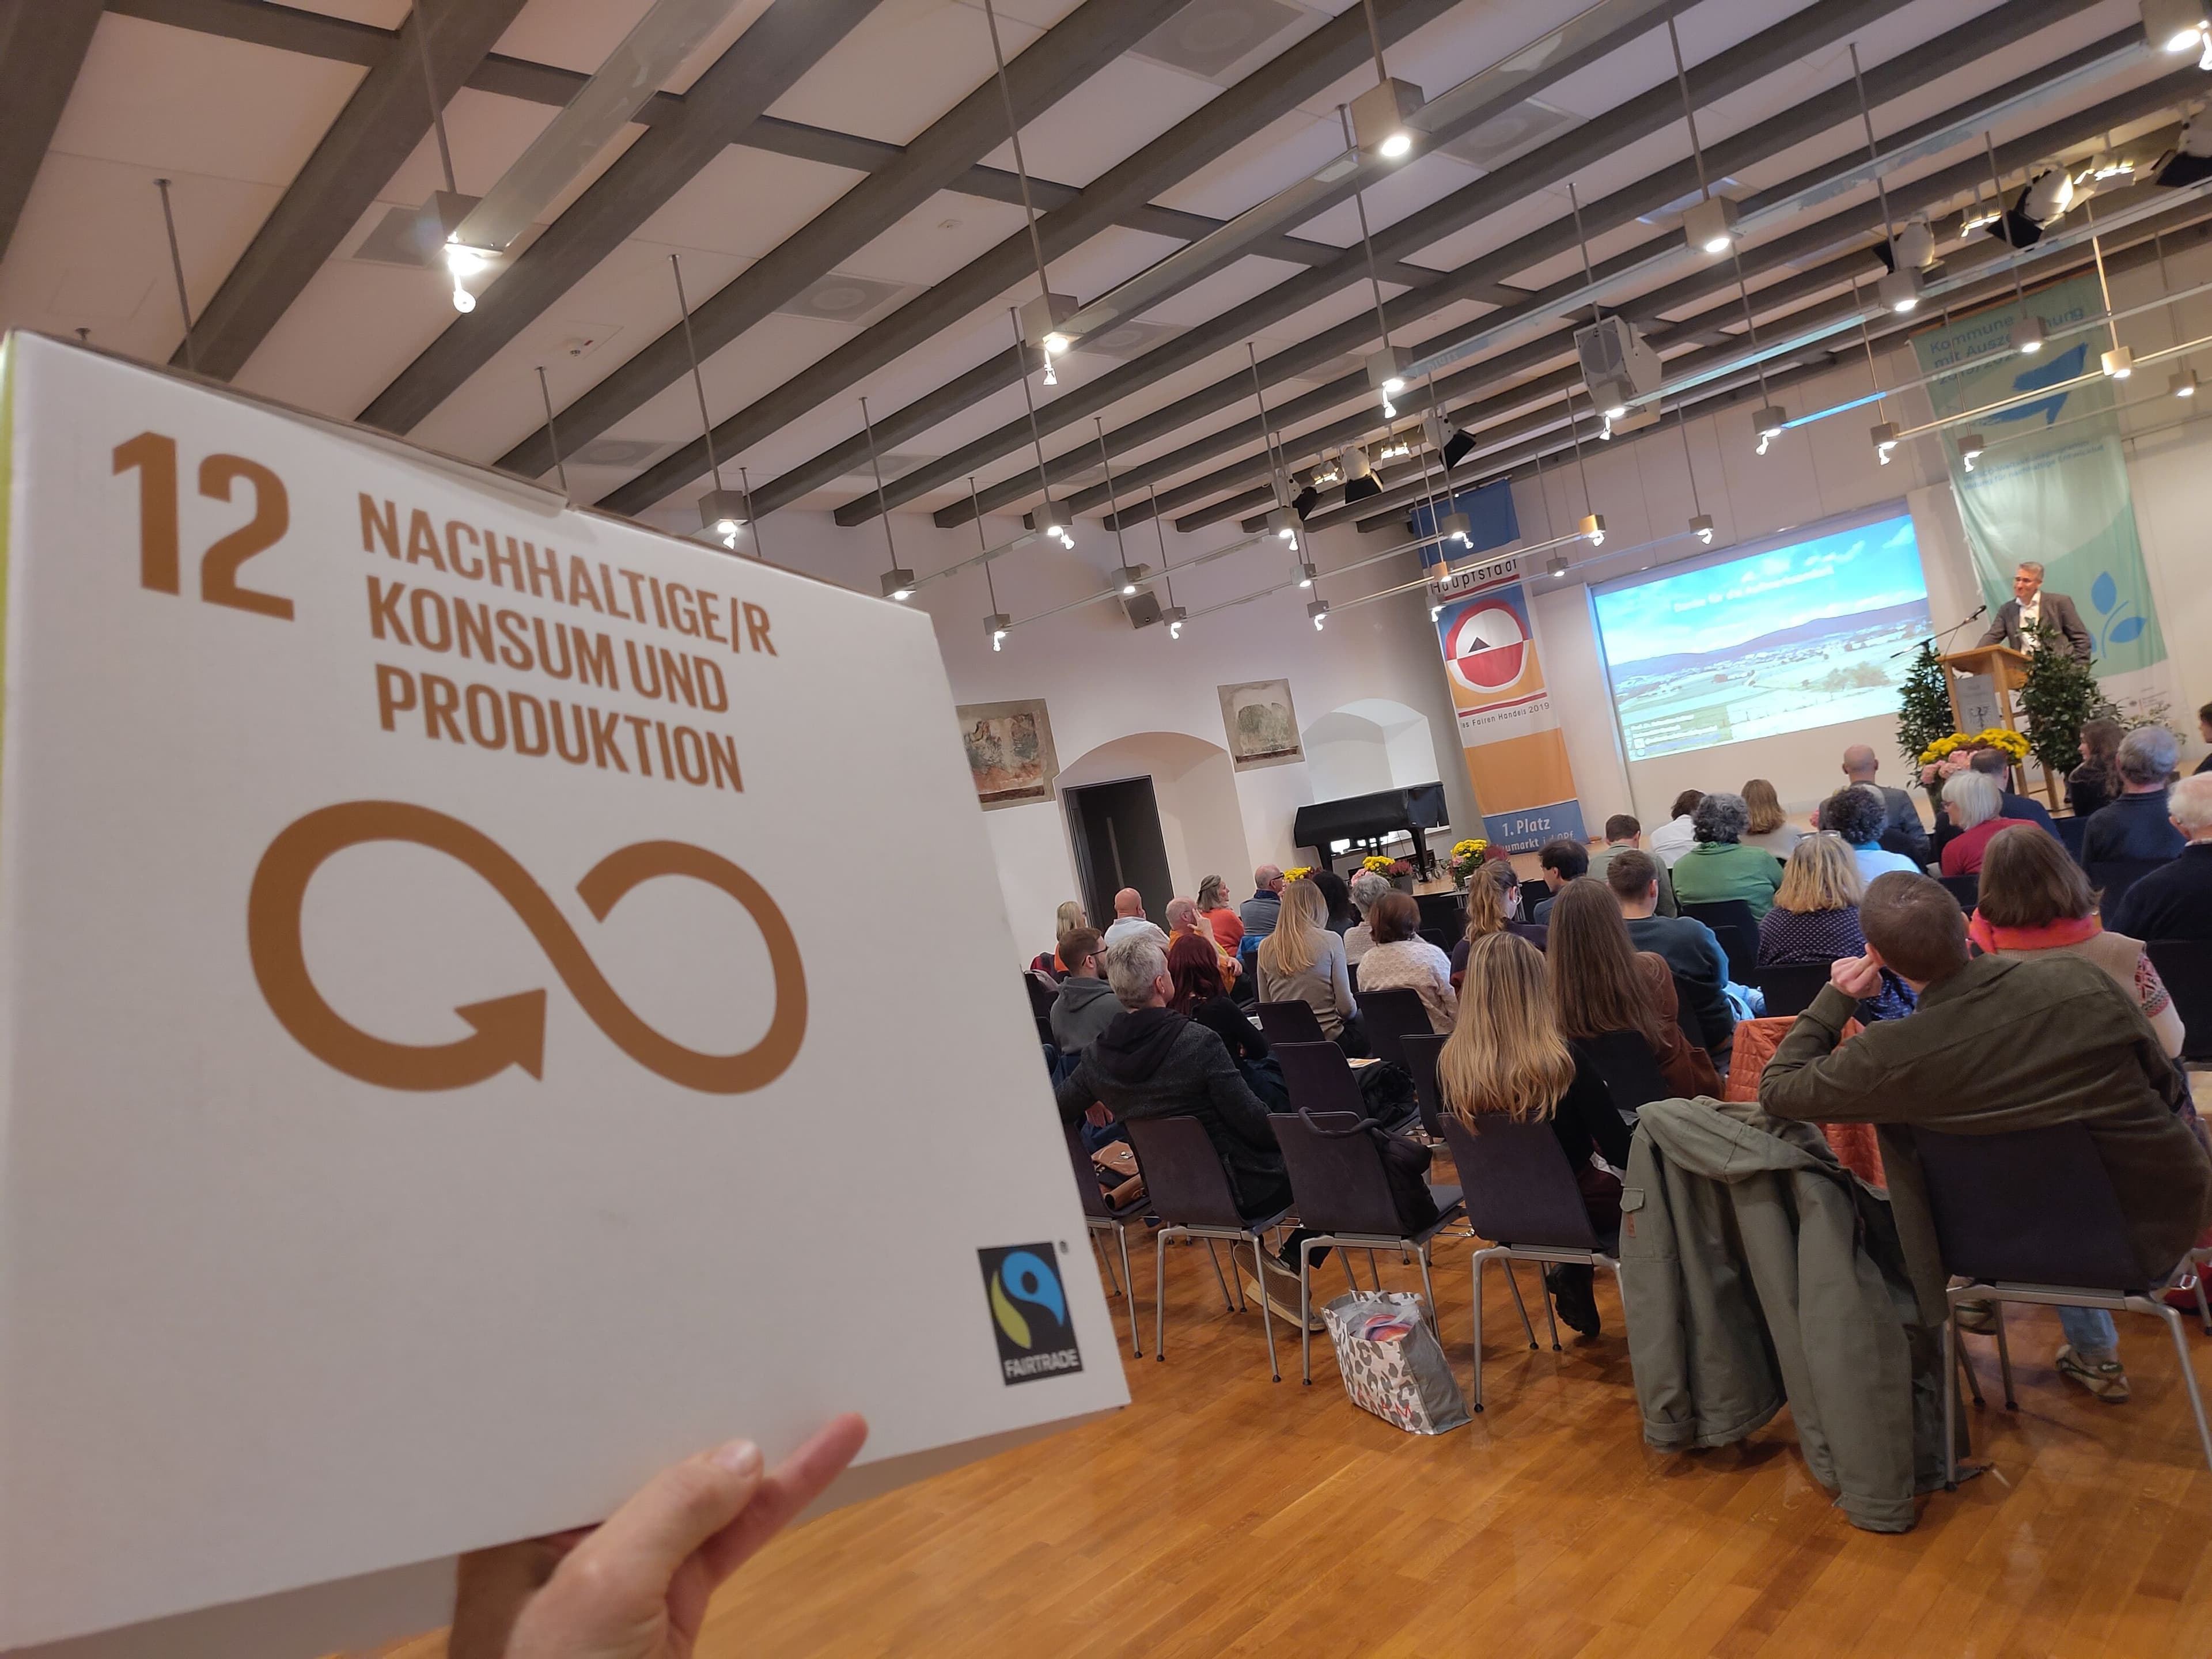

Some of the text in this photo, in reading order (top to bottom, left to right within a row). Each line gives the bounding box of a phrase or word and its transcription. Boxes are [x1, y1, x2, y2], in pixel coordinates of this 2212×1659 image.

[112, 430, 295, 622] 12
[358, 491, 779, 657] NACHHALTIGE/R
[366, 575, 729, 714] KONSUM UND
[374, 663, 745, 793] PRODUKTION
[1472, 716, 1496, 727] Fairen
[1498, 708, 1527, 721] Handels
[1528, 702, 1550, 714] 2019
[1498, 838, 1540, 852] umarkt
[1502, 818, 1551, 836] 1. Platz
[1004, 1349, 1079, 1377] FAIRTRADE
